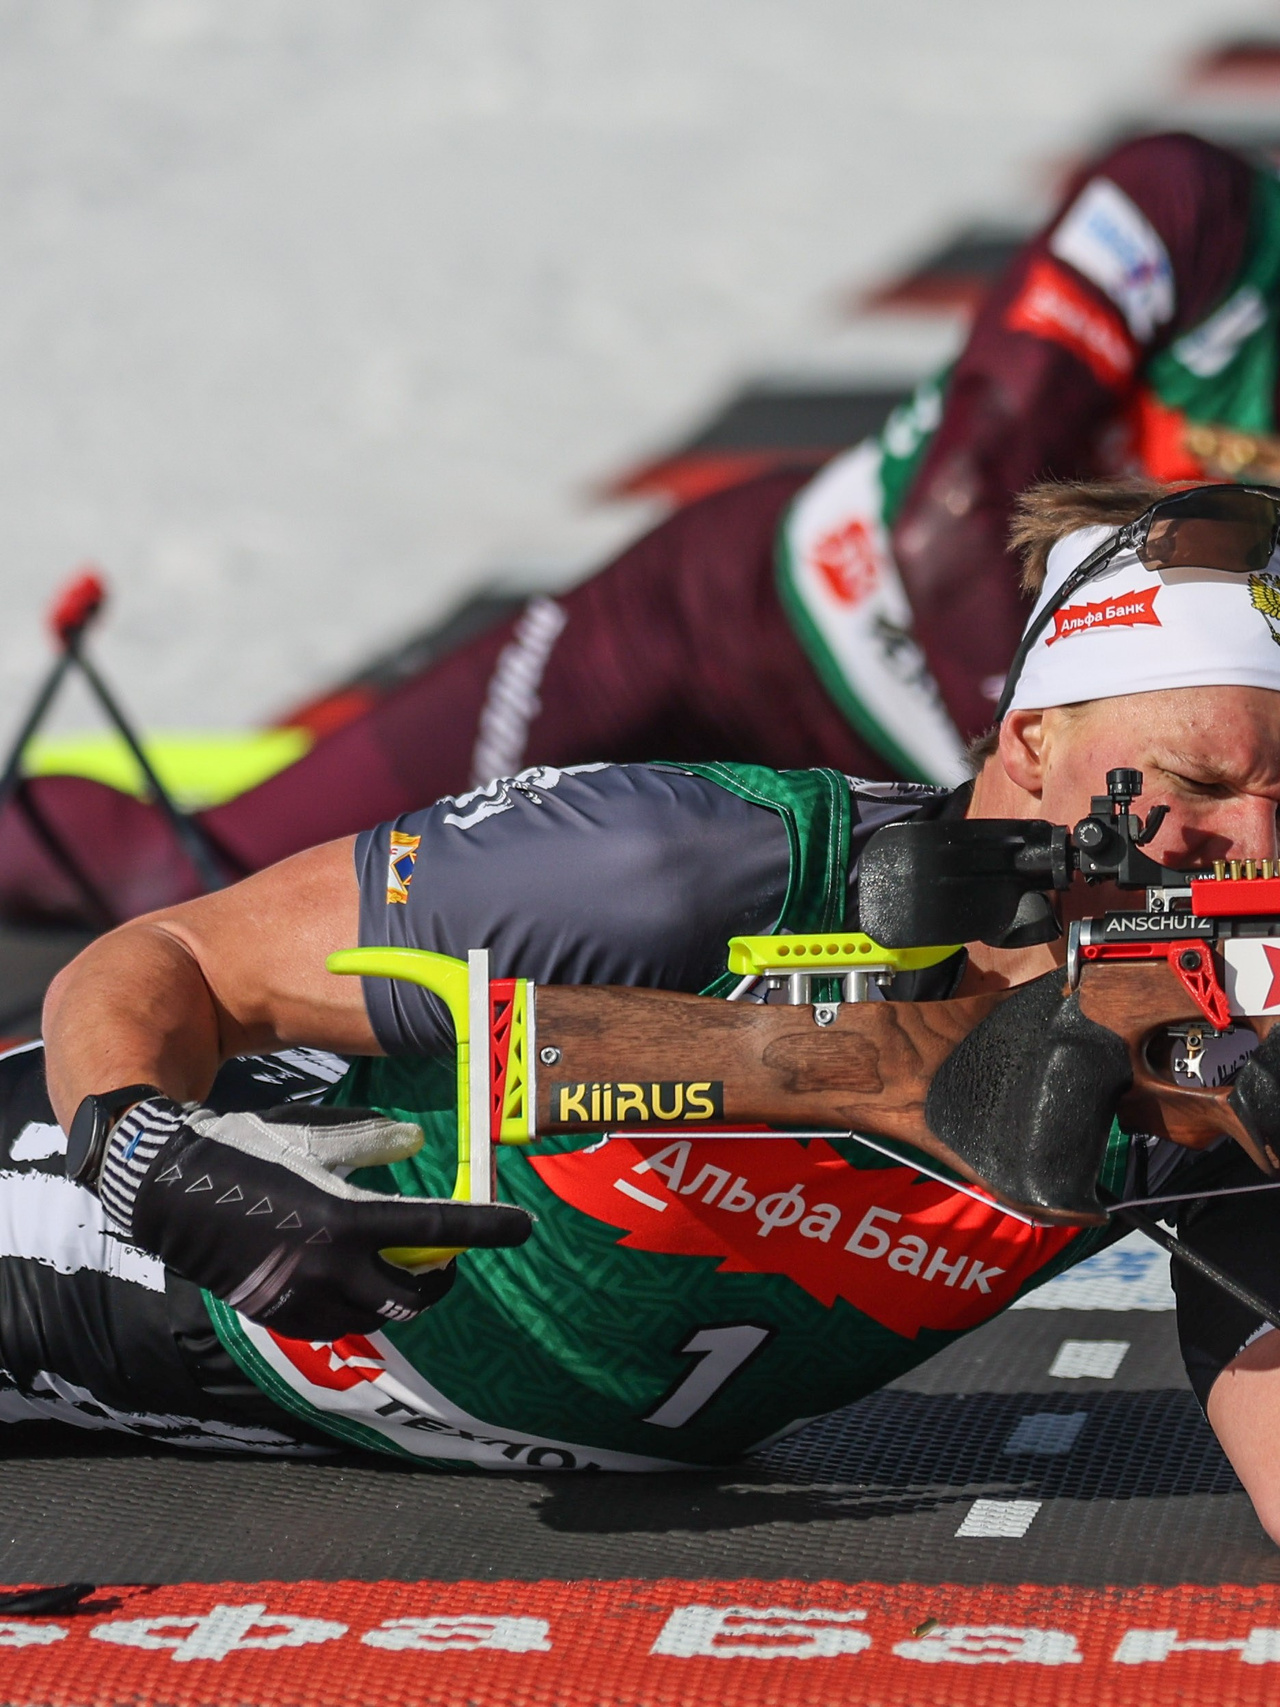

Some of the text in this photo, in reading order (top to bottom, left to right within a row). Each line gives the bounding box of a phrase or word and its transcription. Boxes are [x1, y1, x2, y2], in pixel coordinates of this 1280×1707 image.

[1060, 602, 1145, 633] Альфа Банк
[631, 1139, 1007, 1295] Альфа Банк
[643, 1324, 771, 1430] 1
